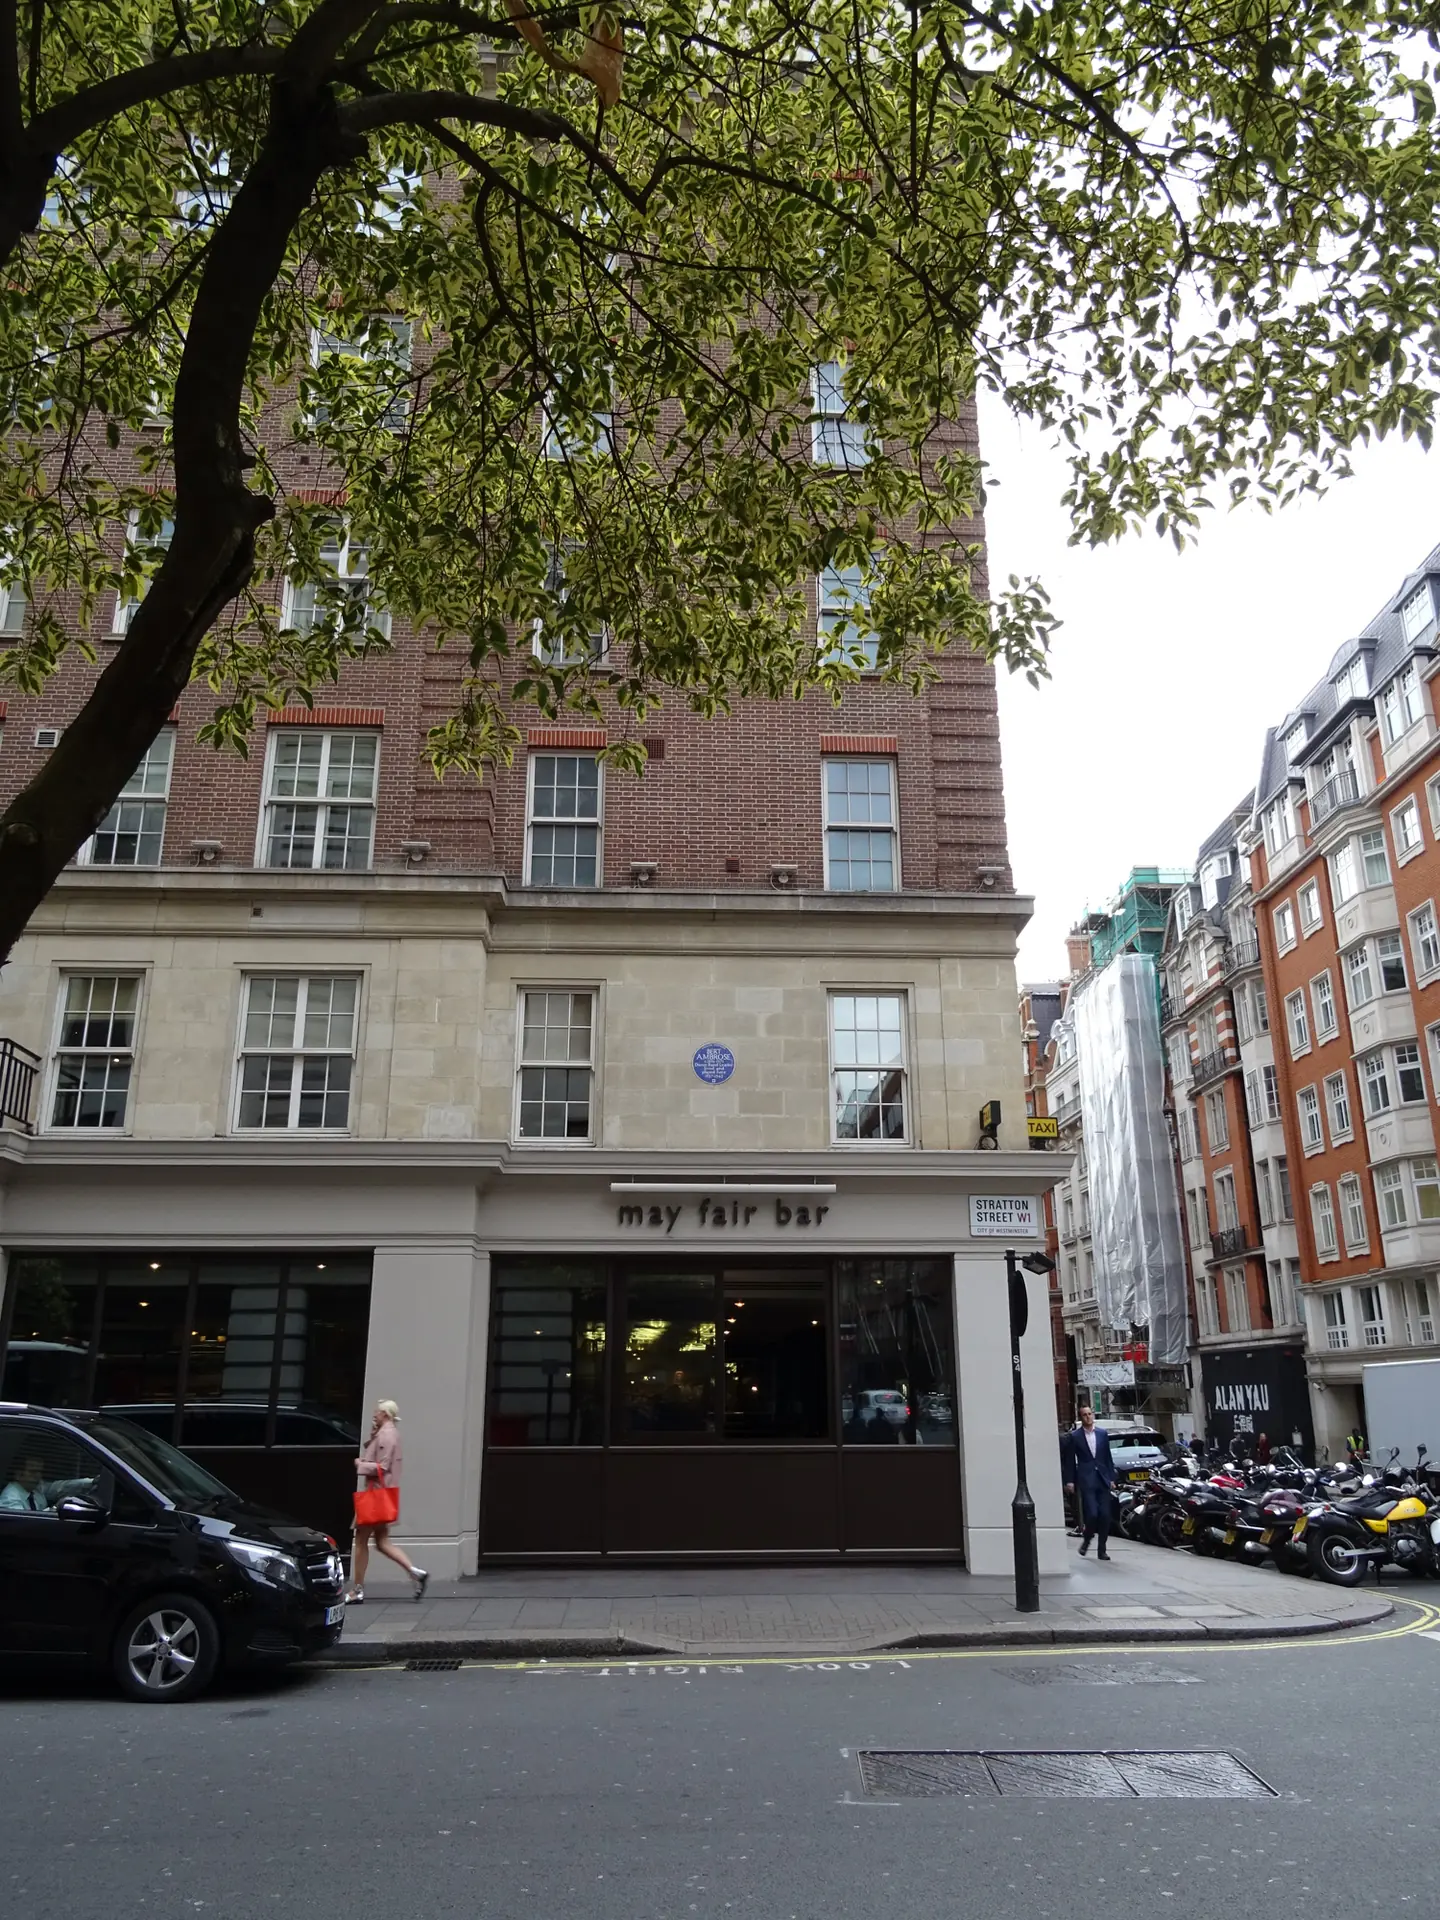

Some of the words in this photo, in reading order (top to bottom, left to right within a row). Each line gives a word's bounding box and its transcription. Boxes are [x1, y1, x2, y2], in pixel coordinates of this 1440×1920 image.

[1028, 1122, 1055, 1133] TAXI
[976, 1199, 1029, 1210] STRATTON
[618, 1204, 682, 1234] may
[700, 1198, 757, 1226] fair
[775, 1198, 830, 1226] bar
[976, 1212, 1013, 1222] STREET
[1017, 1213, 1031, 1223] W1
[1215, 1385, 1245, 1411] ALAN
[1245, 1384, 1269, 1411] YAU
[583, 1665, 744, 1676] RIGHT
[780, 1660, 912, 1672] LOOK
